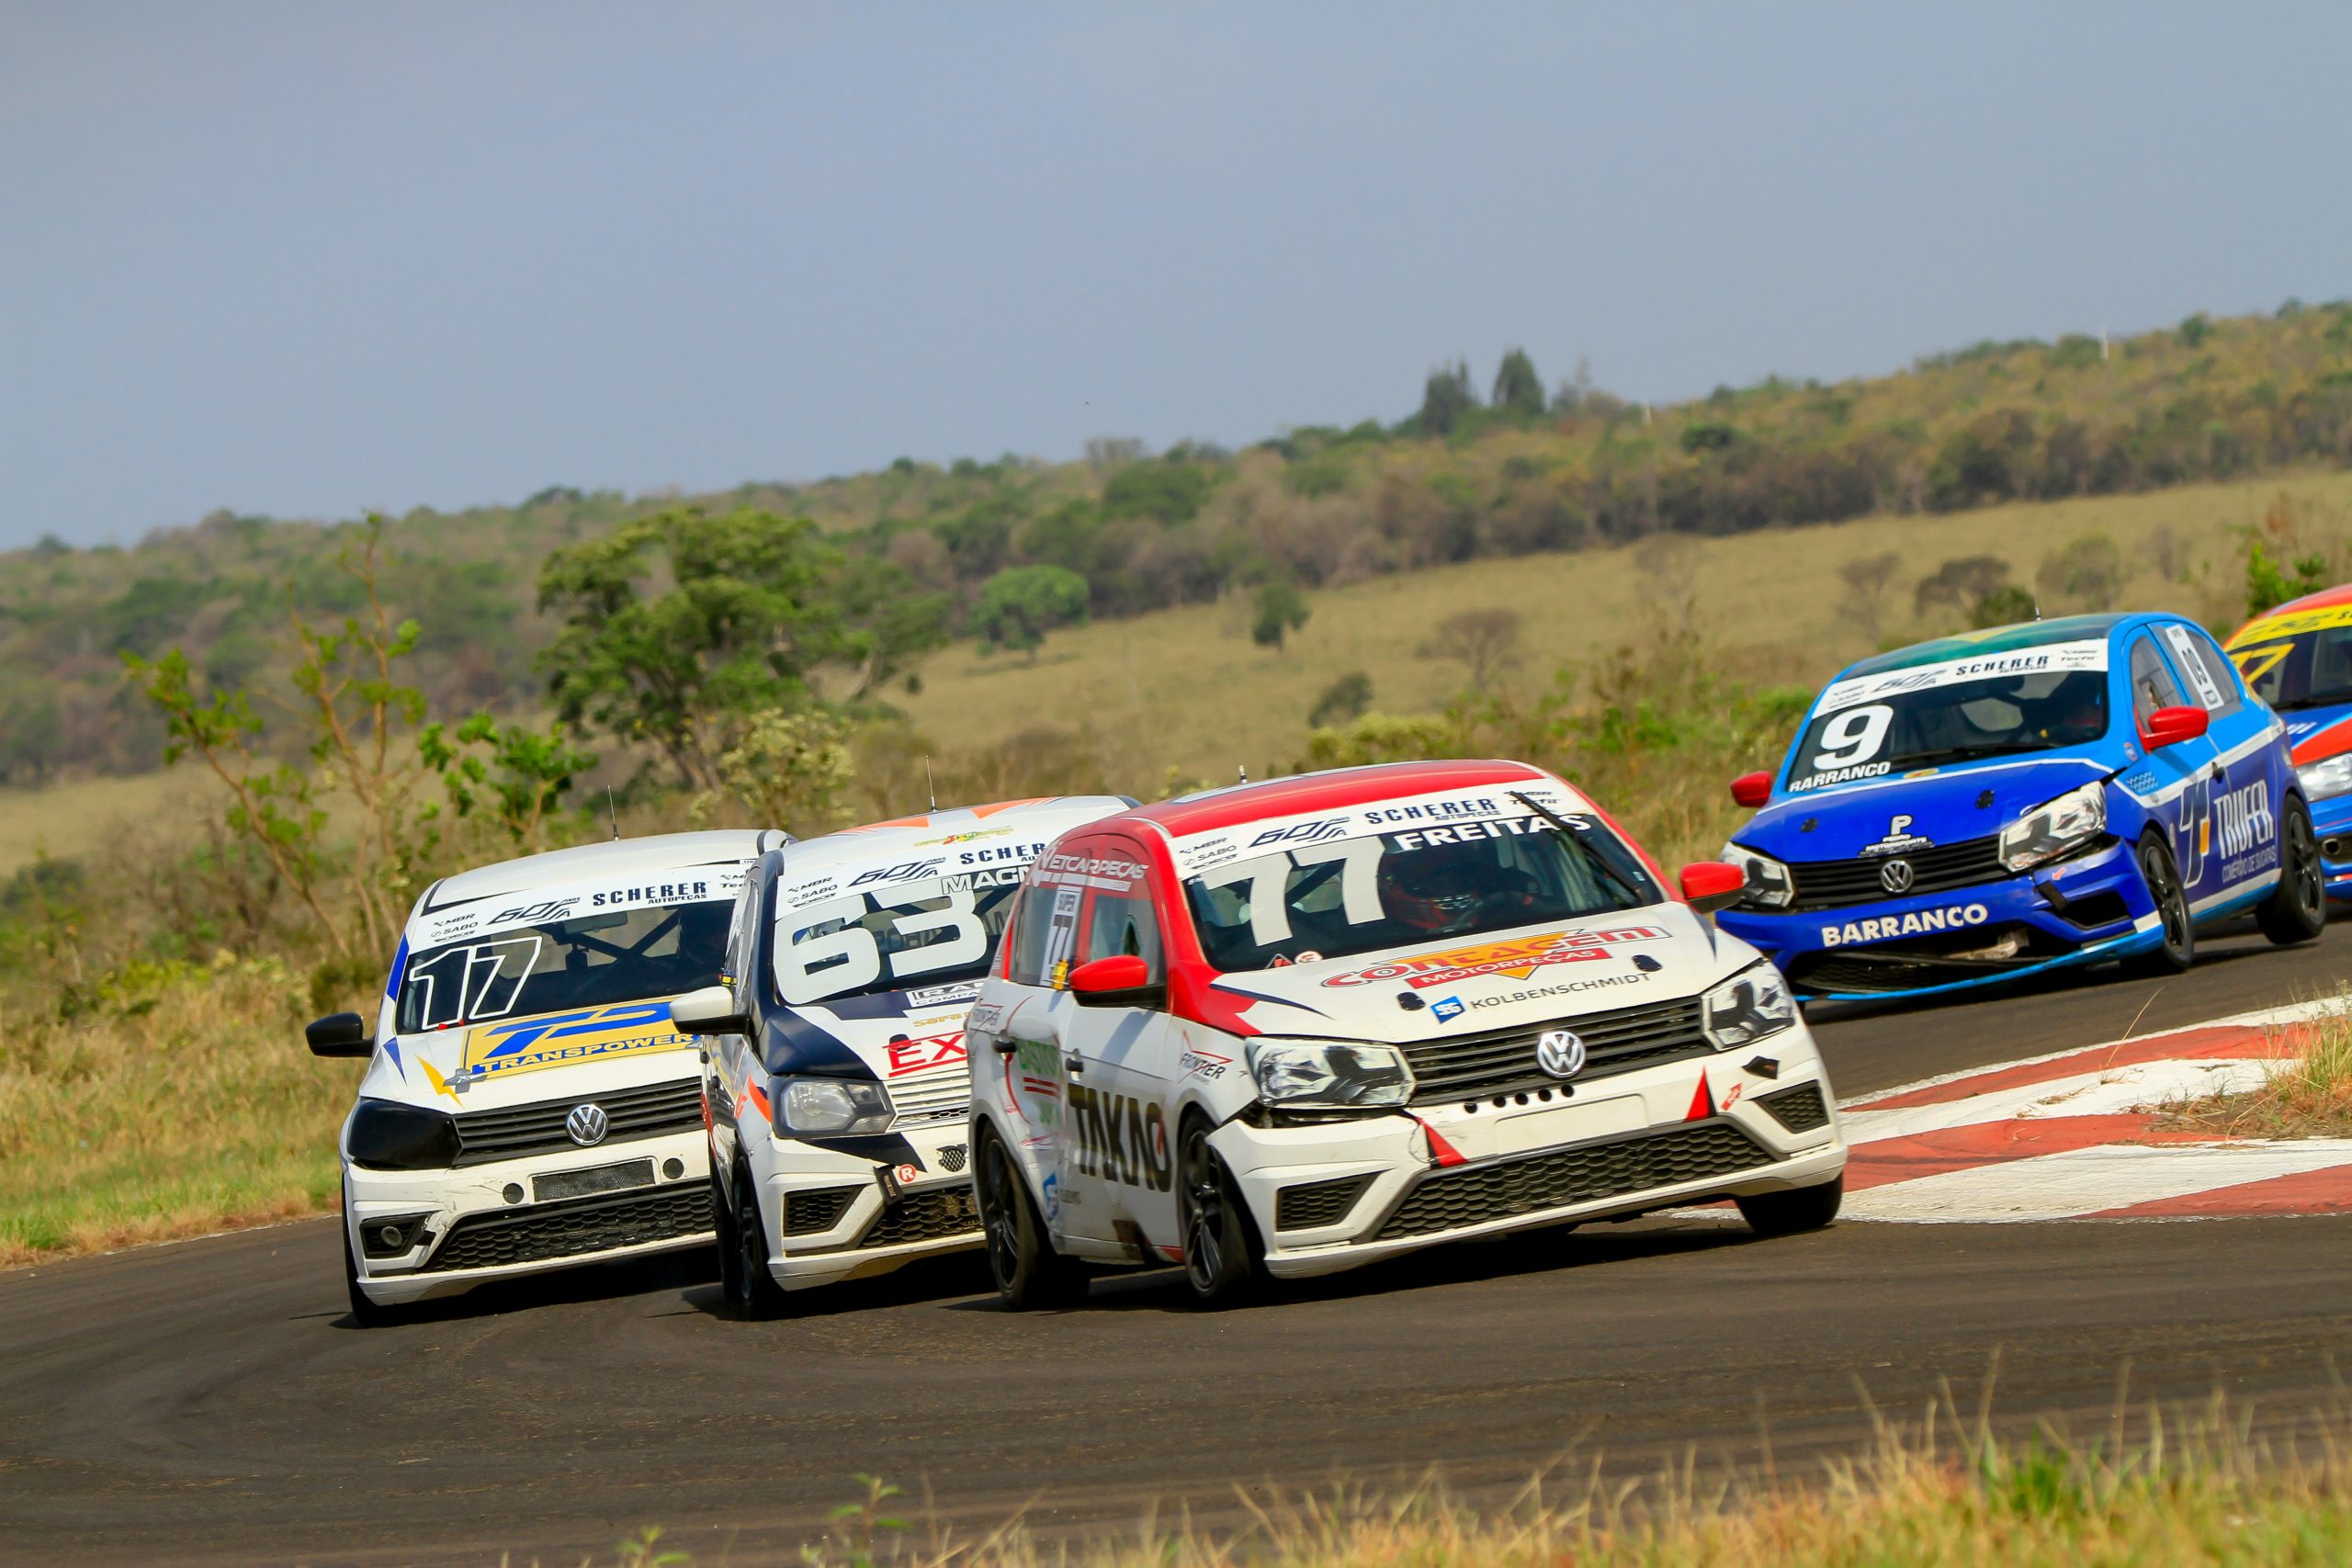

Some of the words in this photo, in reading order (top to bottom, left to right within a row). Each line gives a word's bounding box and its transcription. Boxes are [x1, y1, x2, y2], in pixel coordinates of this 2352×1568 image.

[1814, 705, 1894, 770] 9
[1789, 761, 1891, 792] BARRANCO
[1364, 797, 1498, 824] SCHERER
[1891, 815, 1913, 835] P
[1394, 815, 1591, 852] FREITAS
[593, 881, 707, 907] SCHERER
[1202, 835, 1386, 946] 77
[773, 875, 988, 1005] 63
[1822, 904, 1988, 947] BARRANCO
[409, 936, 542, 1030] 17
[1420, 949, 1598, 983] MOTORPEÇAS
[1470, 973, 1651, 1009] KOLBENSCHMIDT
[479, 1032, 695, 1073] TRANSPOWER
